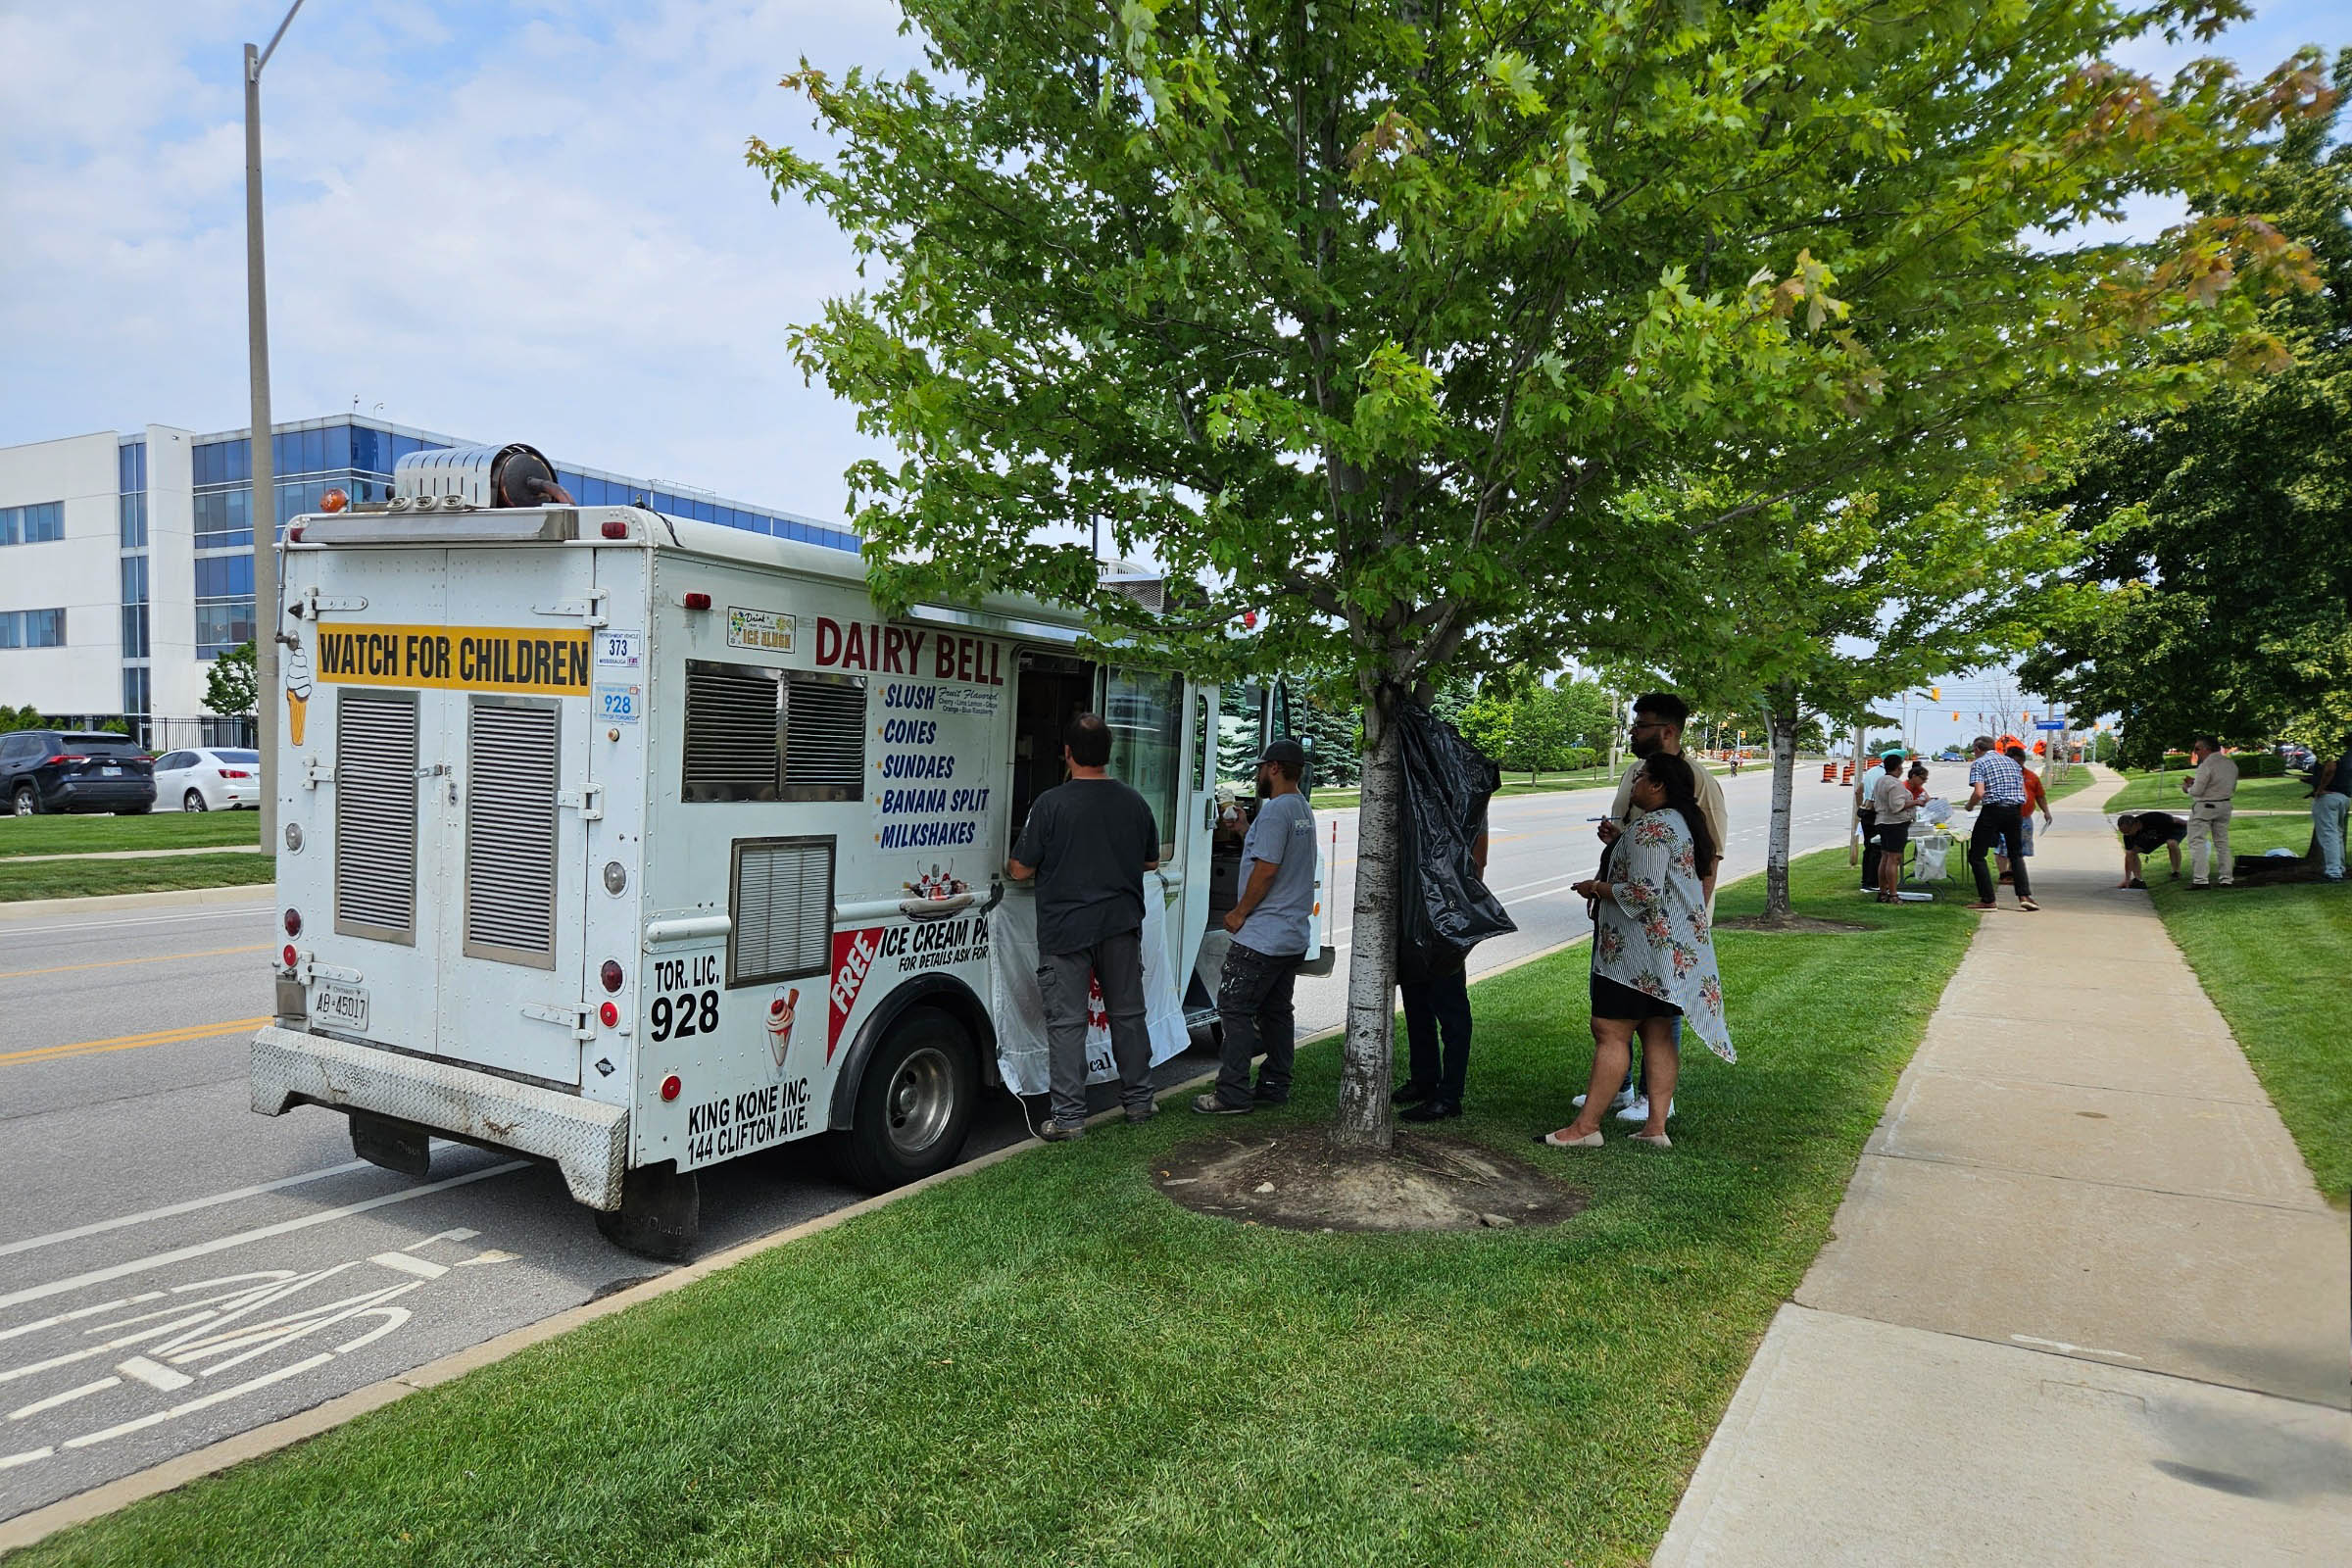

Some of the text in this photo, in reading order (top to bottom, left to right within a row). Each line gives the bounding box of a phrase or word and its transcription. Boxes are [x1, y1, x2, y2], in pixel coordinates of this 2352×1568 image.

[745, 612, 765, 623] Drink
[609, 639, 627, 657] 373
[743, 629, 759, 645] ICE
[319, 633, 589, 686] WATCH FOR CHILDREN
[815, 616, 1004, 686] DAIRY BELL
[605, 695, 631, 713] 928
[885, 683, 935, 710] SLUSH
[938, 687, 961, 698] Fruit
[884, 718, 936, 745] CONES
[883, 755, 955, 779] SUNDAES
[882, 788, 990, 813] BANANA SPLIT
[881, 821, 975, 849] MILKSHAKES
[879, 927, 909, 957] ICE
[912, 919, 969, 953] CREAM
[831, 931, 874, 1014] FREE
[899, 946, 989, 972] FOR DETAILS ASK FOR
[655, 955, 719, 993] TOR. LIC.
[651, 990, 719, 1043] 928
[688, 1078, 811, 1136] KING KONE INC.
[688, 1105, 808, 1165] 144 CLIFTON AVE.
